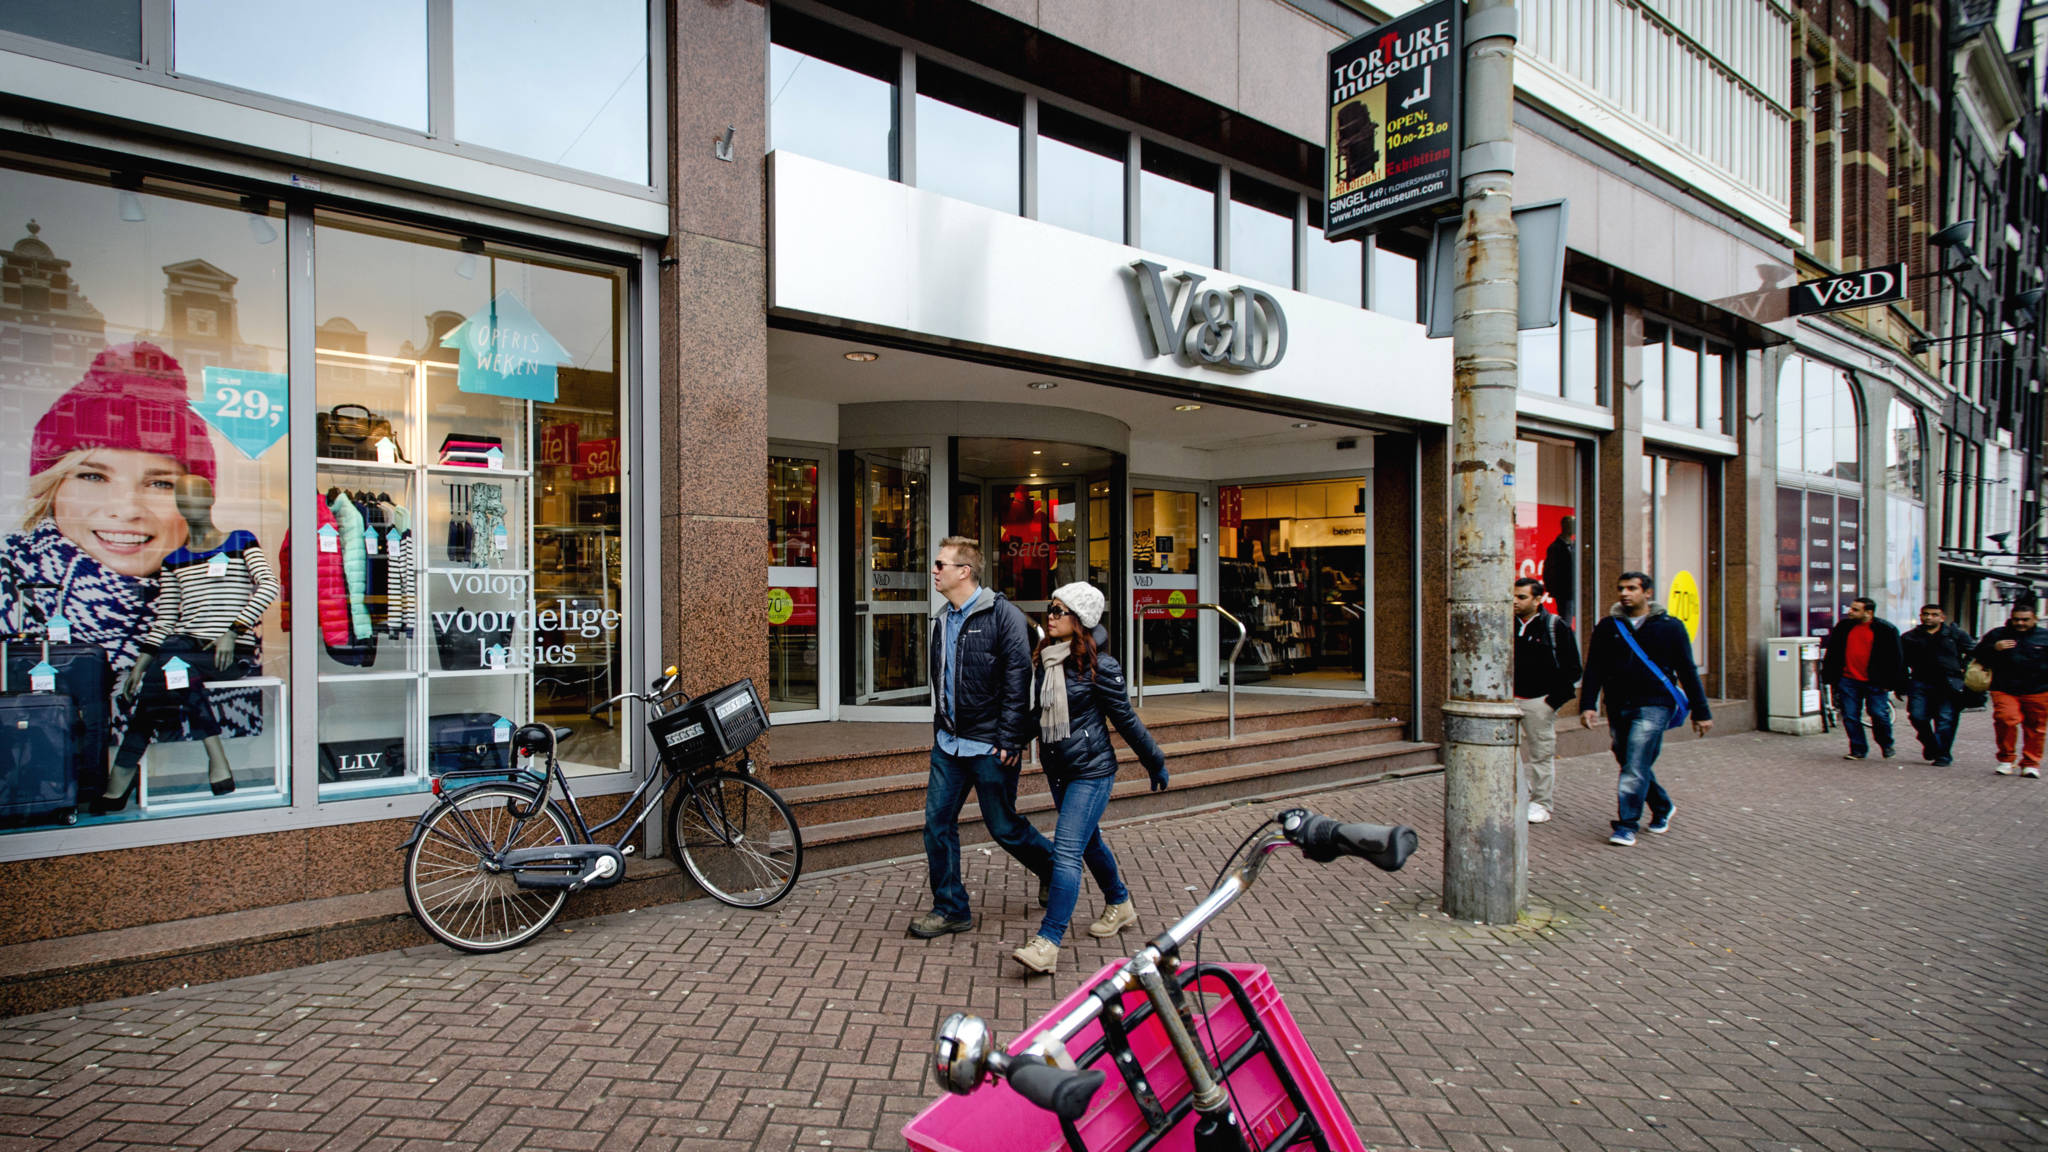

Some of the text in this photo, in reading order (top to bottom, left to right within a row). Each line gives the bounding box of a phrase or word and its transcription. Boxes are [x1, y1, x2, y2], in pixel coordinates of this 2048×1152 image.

[1334, 19, 1449, 87] TORTURE
[1333, 41, 1449, 104] museum
[1386, 110, 1428, 133] OPEN:
[1386, 122, 1448, 150] 10.00-23.00
[1329, 192, 1366, 214] SINGEL
[1368, 187, 1384, 200] 449
[1331, 181, 1444, 224] www.torturemuseum.com
[1805, 270, 1894, 307] V&D
[1128, 258, 1289, 371] V&D
[1007, 535, 1050, 558] sale
[445, 567, 527, 601] Volop
[873, 573, 891, 586] V&D
[1133, 575, 1154, 587] V&D
[432, 599, 620, 639] voordelige
[477, 636, 577, 668] basics
[338, 752, 383, 770] LIV
